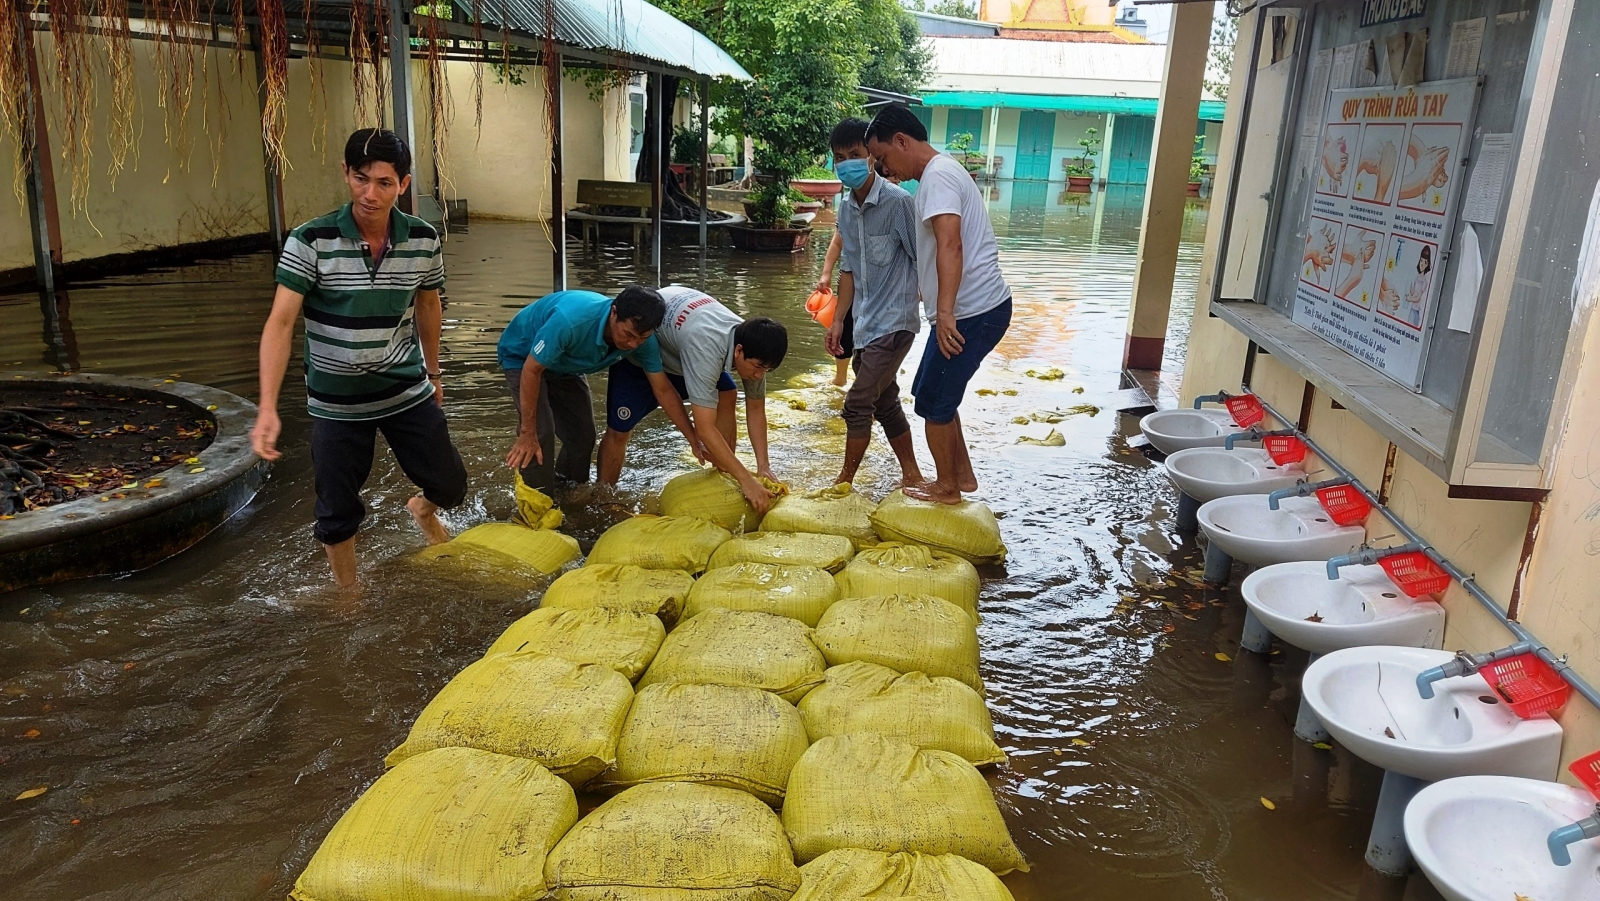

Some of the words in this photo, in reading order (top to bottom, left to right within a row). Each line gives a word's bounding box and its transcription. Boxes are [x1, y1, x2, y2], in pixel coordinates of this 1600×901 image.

[1342, 98, 1362, 121] QUY
[1362, 92, 1393, 118] TRÌNH
[1394, 88, 1418, 117] RỬA
[1421, 93, 1449, 117] TAY
[1434, 195, 1440, 204] 3
